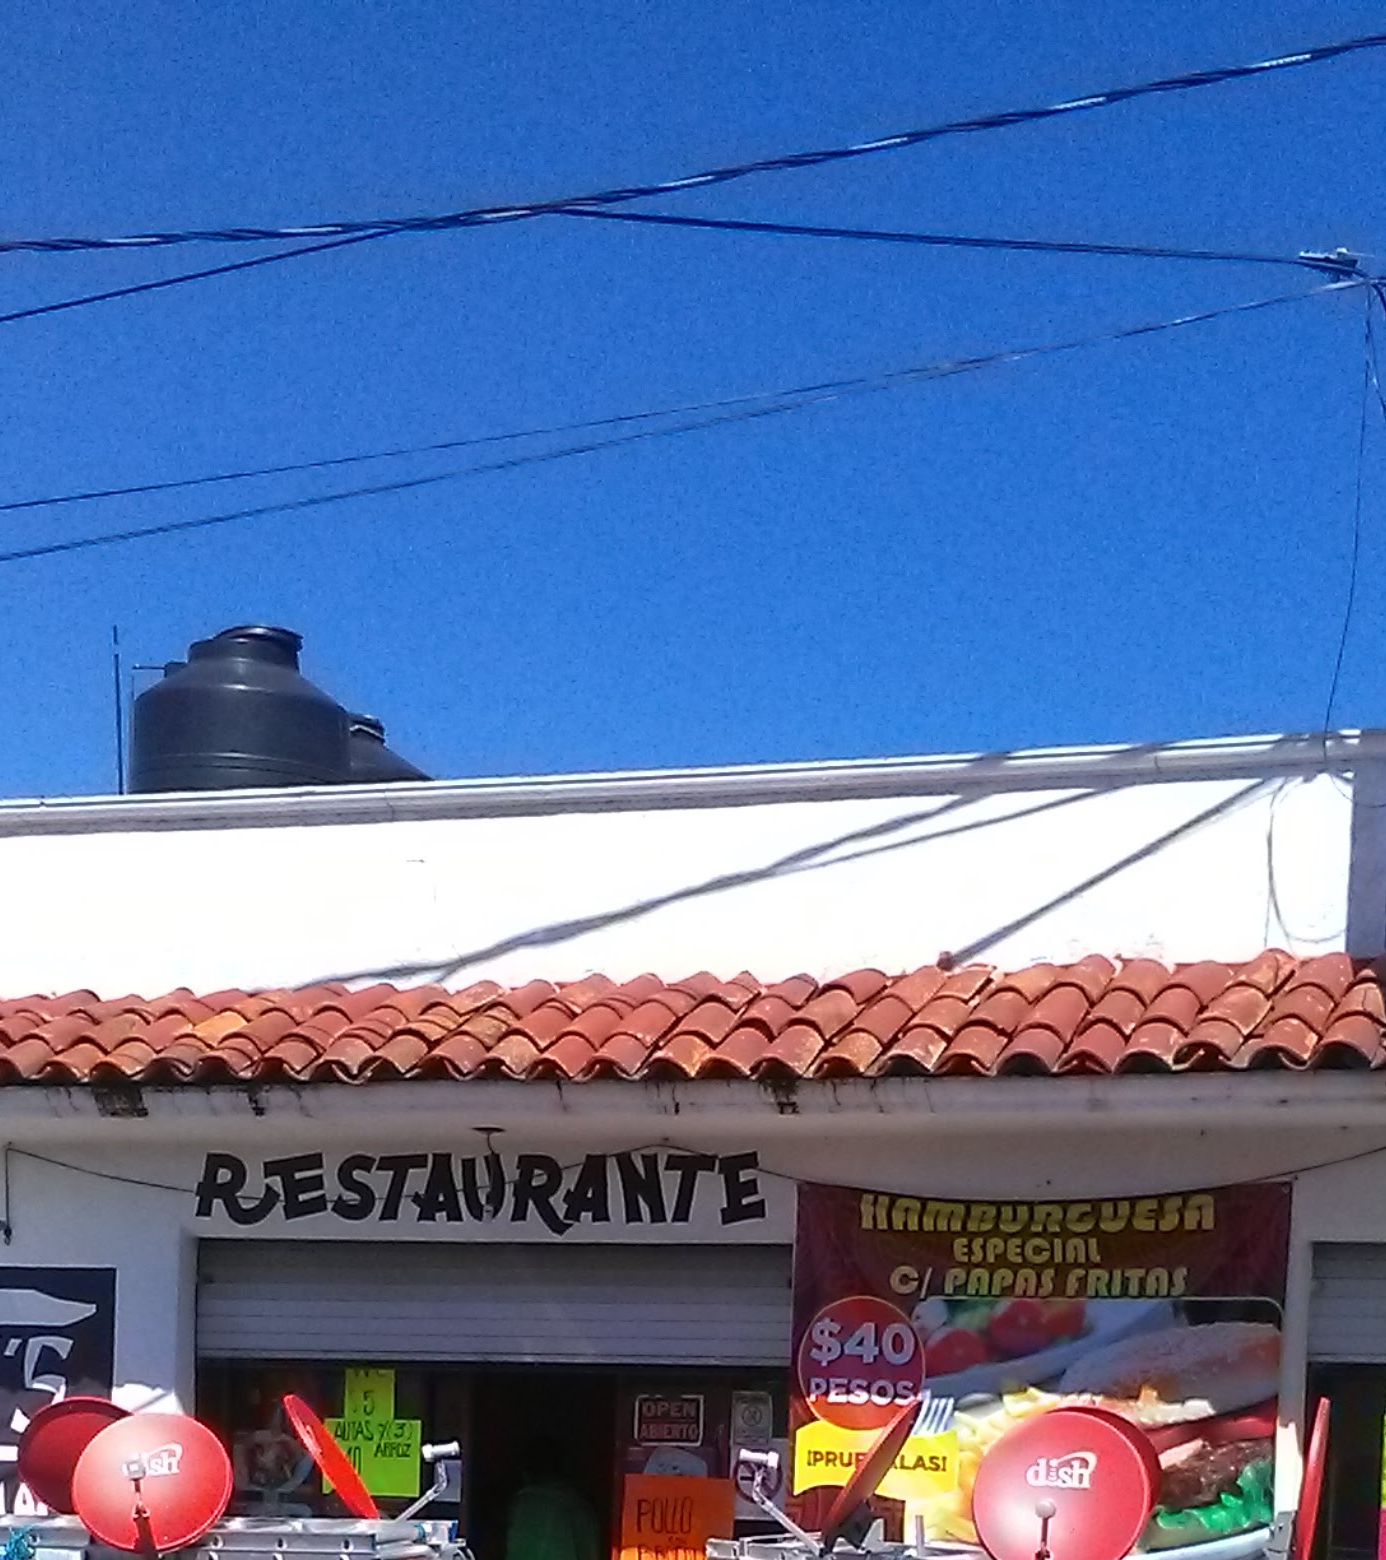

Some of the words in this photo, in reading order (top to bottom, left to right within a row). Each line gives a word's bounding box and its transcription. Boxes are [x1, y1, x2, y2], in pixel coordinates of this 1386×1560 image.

[195, 1151, 766, 1237] RESTAURANTE
[860, 1193, 1215, 1234] HAMBURGUESA
[952, 1236, 1101, 1265] ESPECIAL
[889, 1264, 933, 1300] C/
[944, 1266, 1055, 1297] PAPAS
[1065, 1265, 1188, 1297] FRITAS
[809, 1317, 916, 1367] $40
[641, 1401, 697, 1419] OPEN
[808, 1376, 915, 1407] PESOS
[639, 1423, 699, 1441] ABIERTO
[1026, 1451, 1097, 1489] dish
[636, 1496, 694, 1535] POLLO
